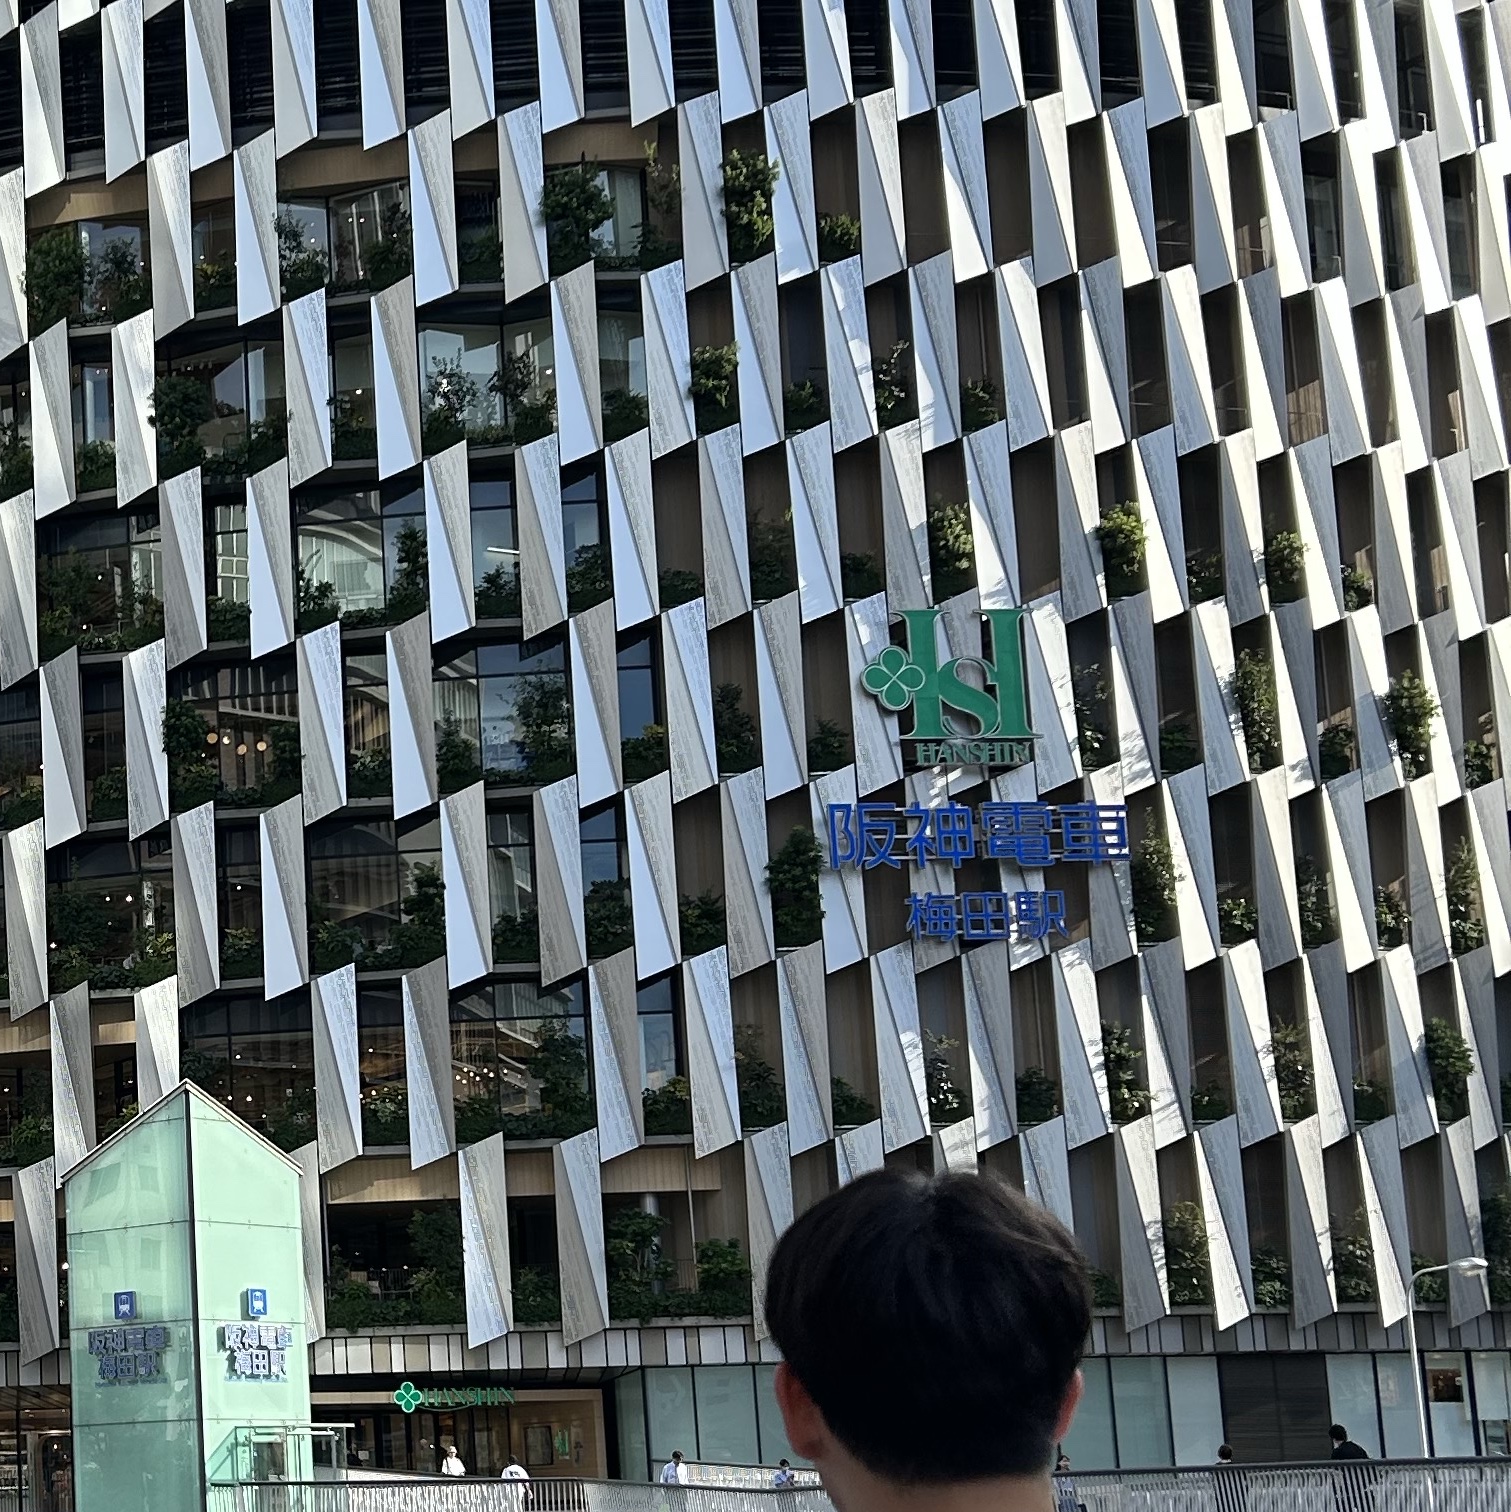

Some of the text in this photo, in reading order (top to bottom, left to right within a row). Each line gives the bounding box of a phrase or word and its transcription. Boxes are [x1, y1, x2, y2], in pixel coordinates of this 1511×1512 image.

[915, 741, 1032, 768] HANSHIN
[827, 802, 1131, 871] 阪神電車
[906, 890, 1069, 942] 梅田駅
[421, 1386, 515, 1407] HANSHIN
